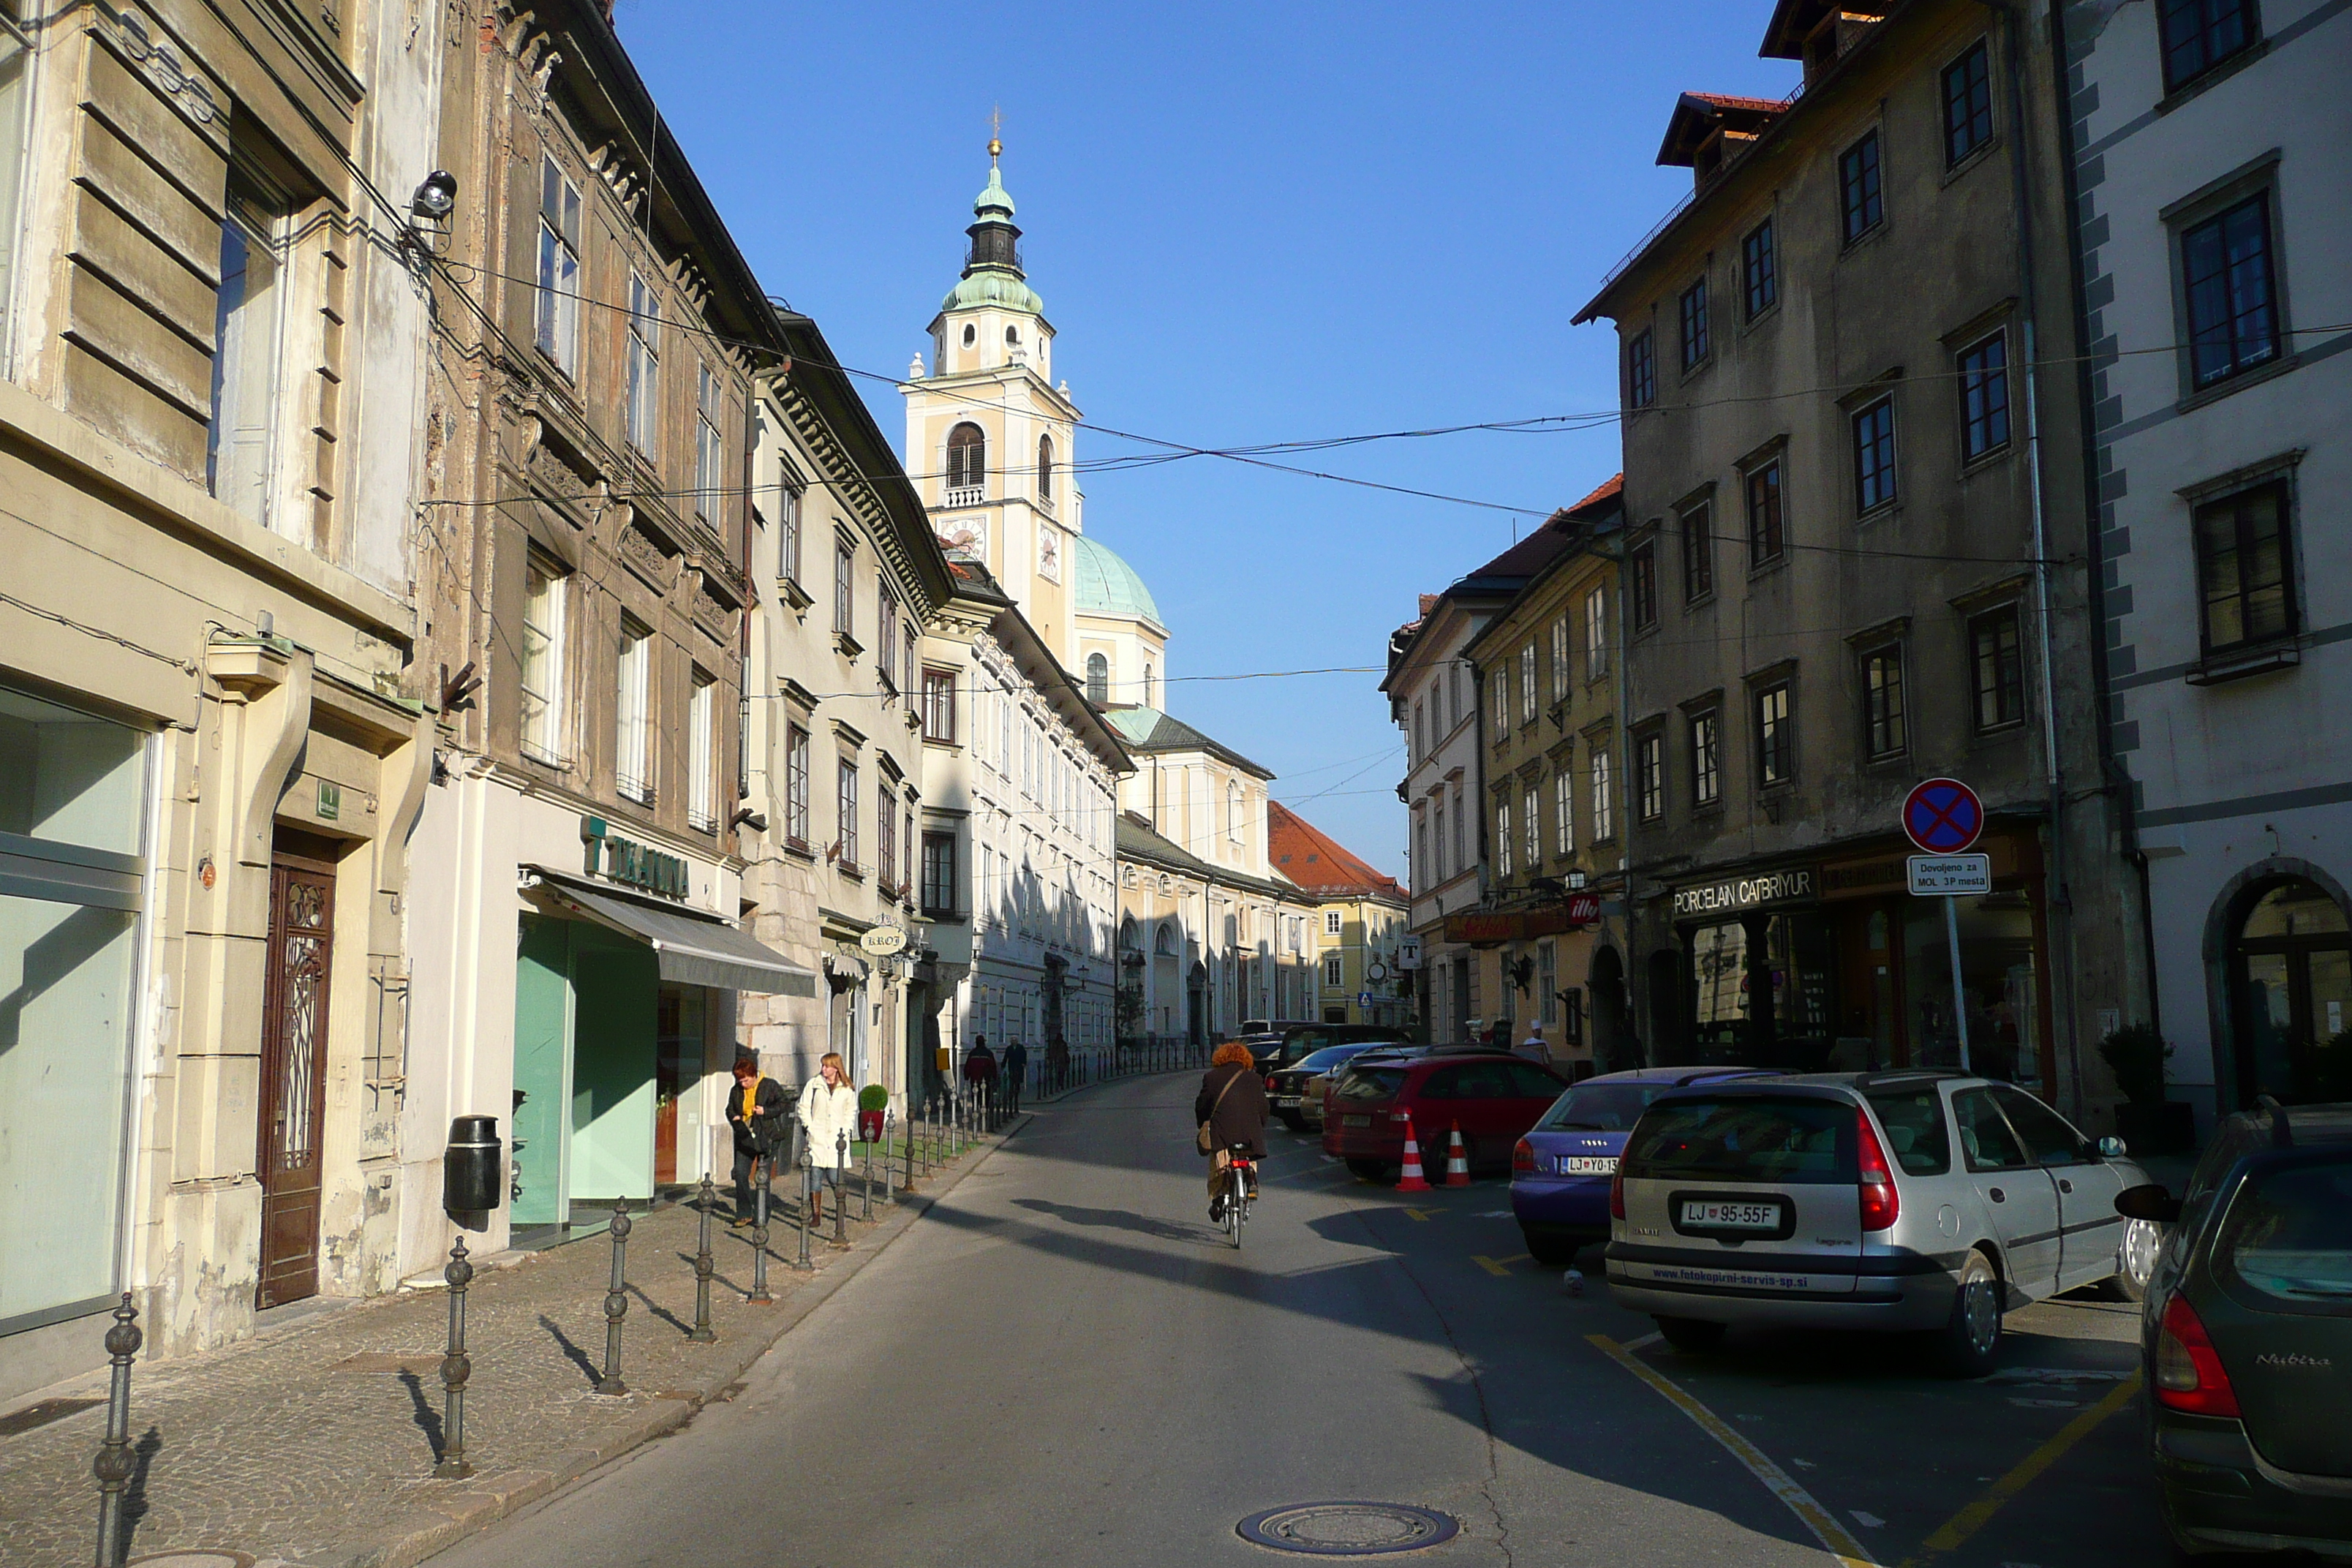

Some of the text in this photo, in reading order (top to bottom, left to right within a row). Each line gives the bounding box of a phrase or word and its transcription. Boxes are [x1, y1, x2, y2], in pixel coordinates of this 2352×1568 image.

[606, 835, 690, 899] TKANINA
[1921, 863, 1962, 873] Dovoljeno
[1918, 878, 1938, 886] MOL
[1959, 877, 1985, 886] mesta
[1674, 883, 1736, 914] PORCELAN
[1572, 898, 1599, 921] illy
[867, 936, 900, 946] KROJ
[1403, 946, 1418, 959] T
[1569, 1158, 1583, 1171] LJ
[1688, 1204, 1772, 1224] LJ 95-55F
[2255, 1352, 2332, 1366] Nubira
